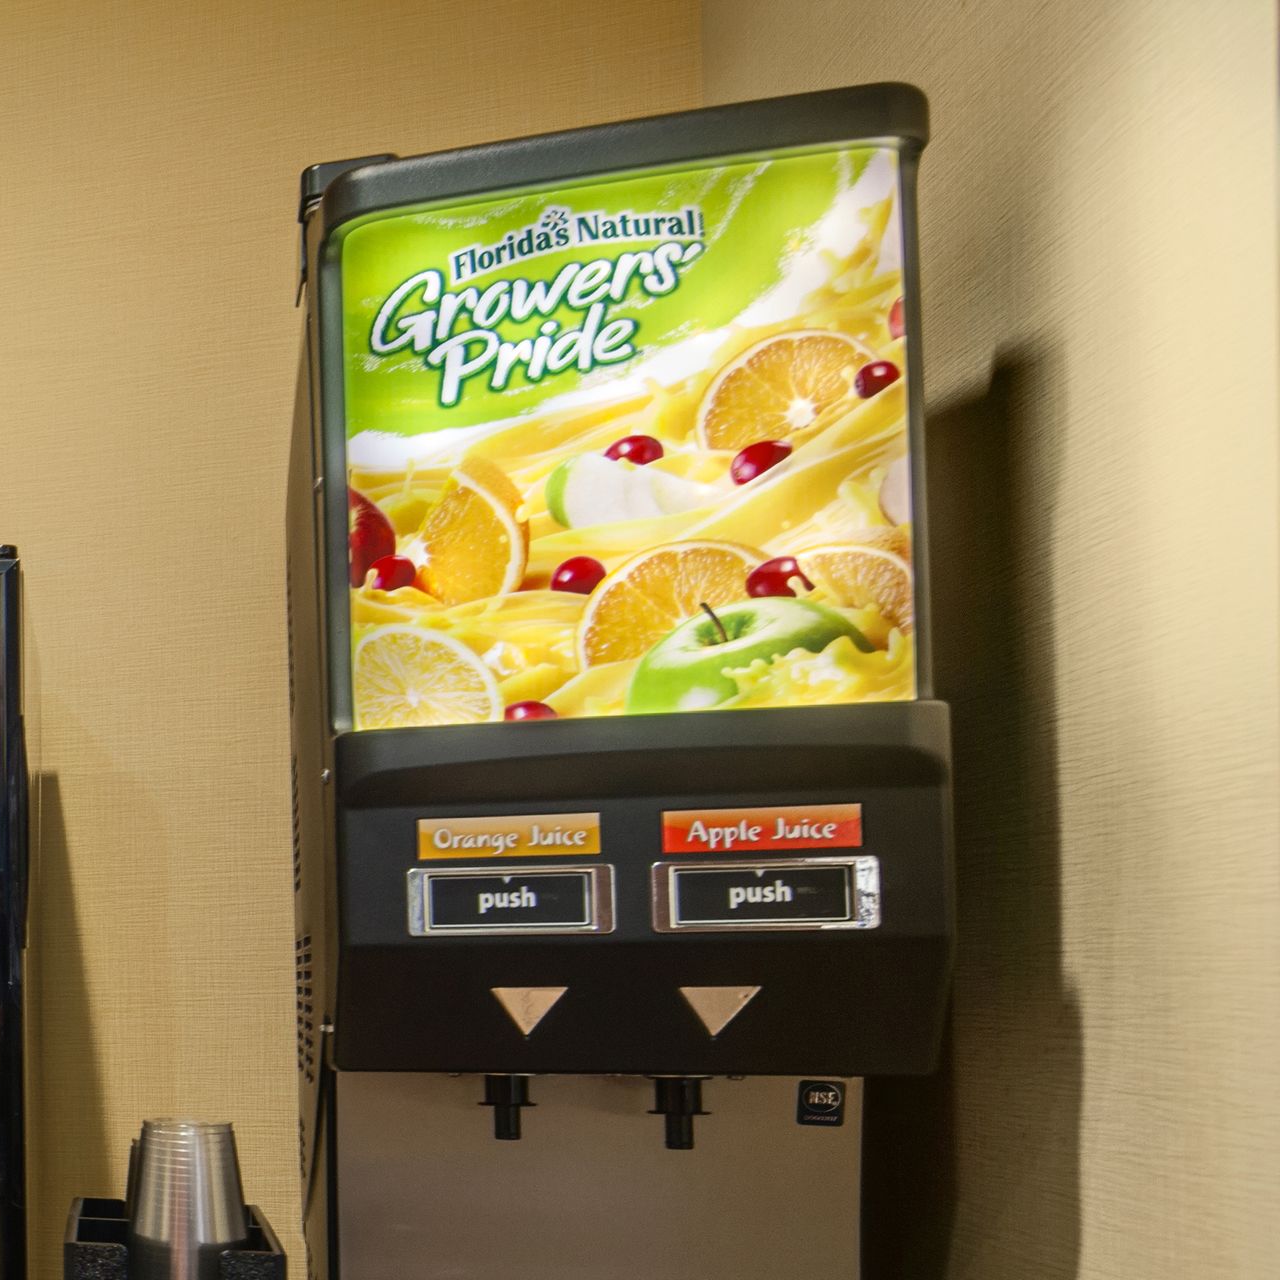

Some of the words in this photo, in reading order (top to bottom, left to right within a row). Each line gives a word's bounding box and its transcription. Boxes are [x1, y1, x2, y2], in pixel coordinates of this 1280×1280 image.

[454, 227, 569, 280] Florida's
[427, 304, 636, 407] Pride
[433, 828, 519, 855] Orange
[527, 825, 587, 846] Juice
[687, 820, 762, 849] Apple
[772, 817, 838, 840] Juice
[478, 886, 537, 914] push
[729, 880, 792, 909] push
[808, 1091, 836, 1104] NSF
